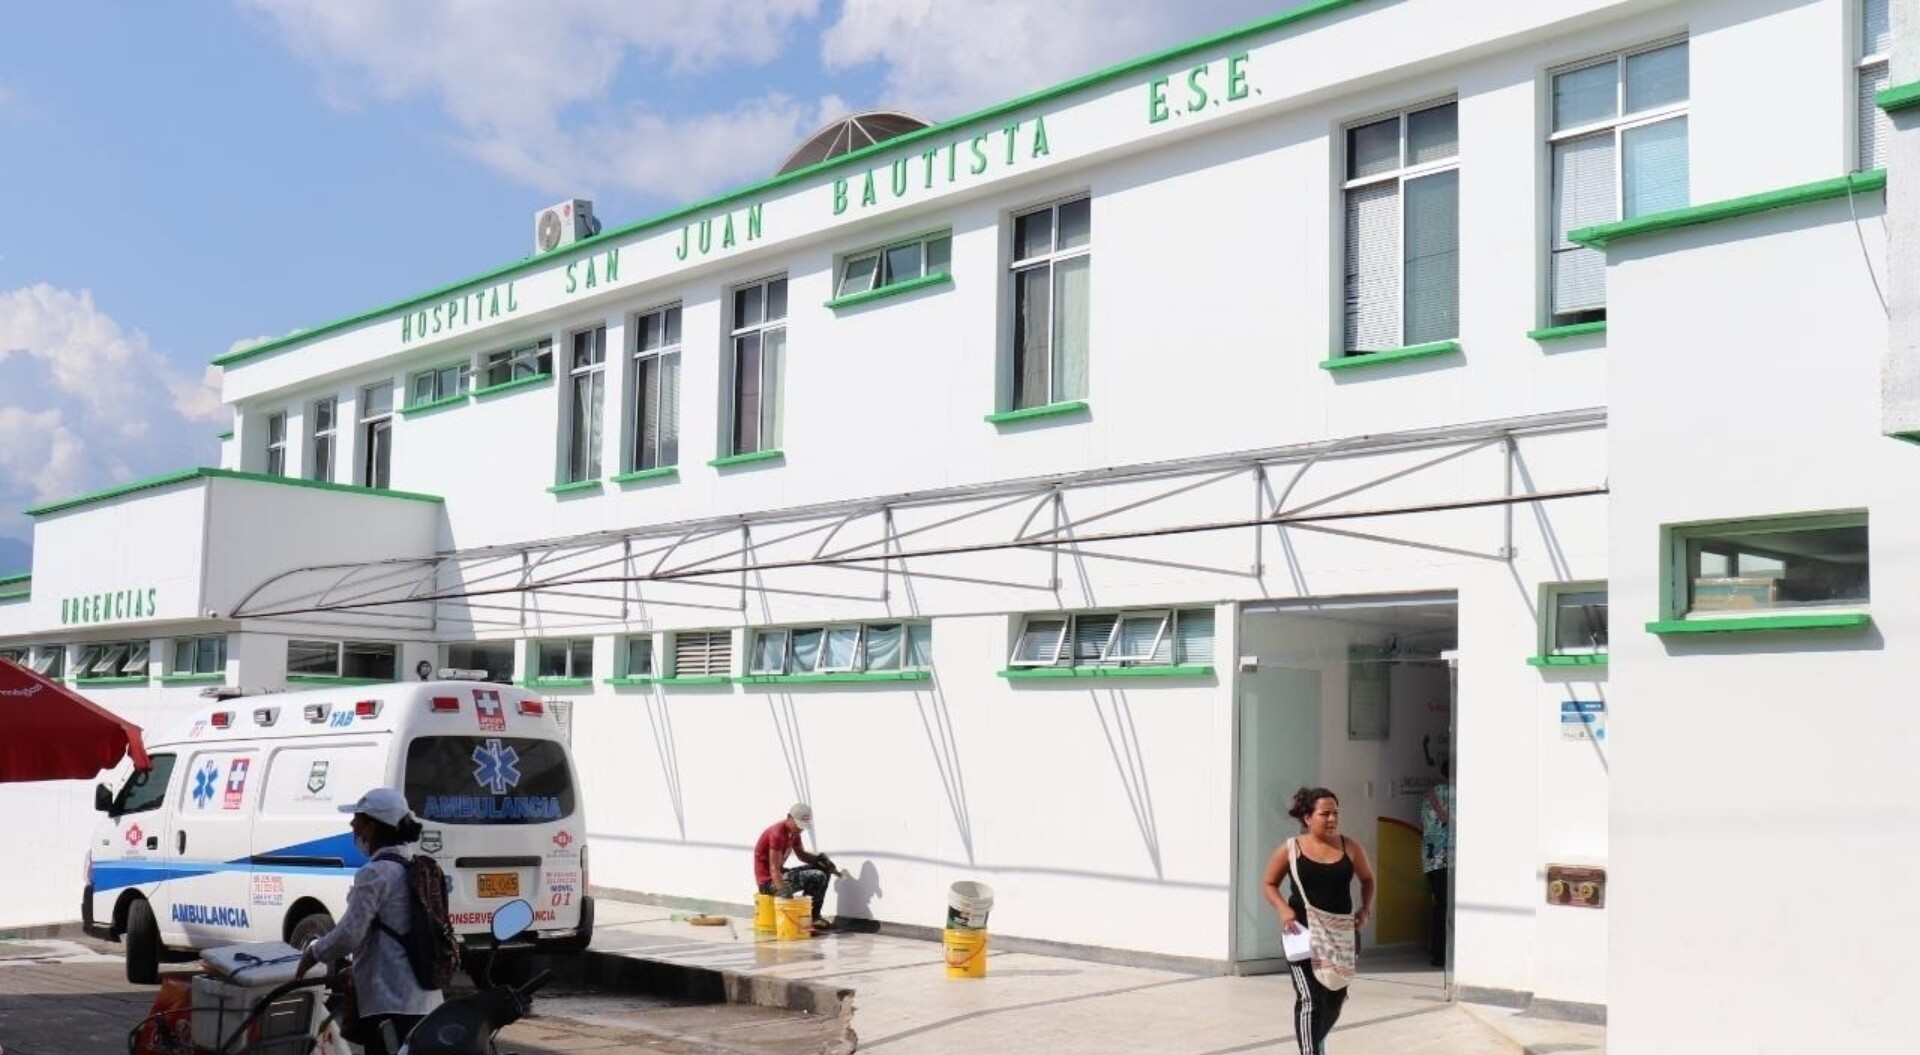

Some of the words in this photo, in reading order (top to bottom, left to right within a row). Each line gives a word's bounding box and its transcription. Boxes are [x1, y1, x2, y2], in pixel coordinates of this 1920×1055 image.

[401, 282, 518, 344] HOSPITAL
[565, 248, 620, 294] SAN
[677, 202, 763, 260] JUAN
[831, 116, 1051, 216] BAUTISTA
[1147, 51, 1263, 124] E.S.E.
[62, 587, 157, 624] URGENCIAS
[330, 710, 355, 728] TAB
[424, 796, 561, 818] AMBULANCIA
[551, 893, 571, 906] 01
[172, 903, 250, 928] AMBULANCIA
[446, 912, 493, 925] ONSERVE
